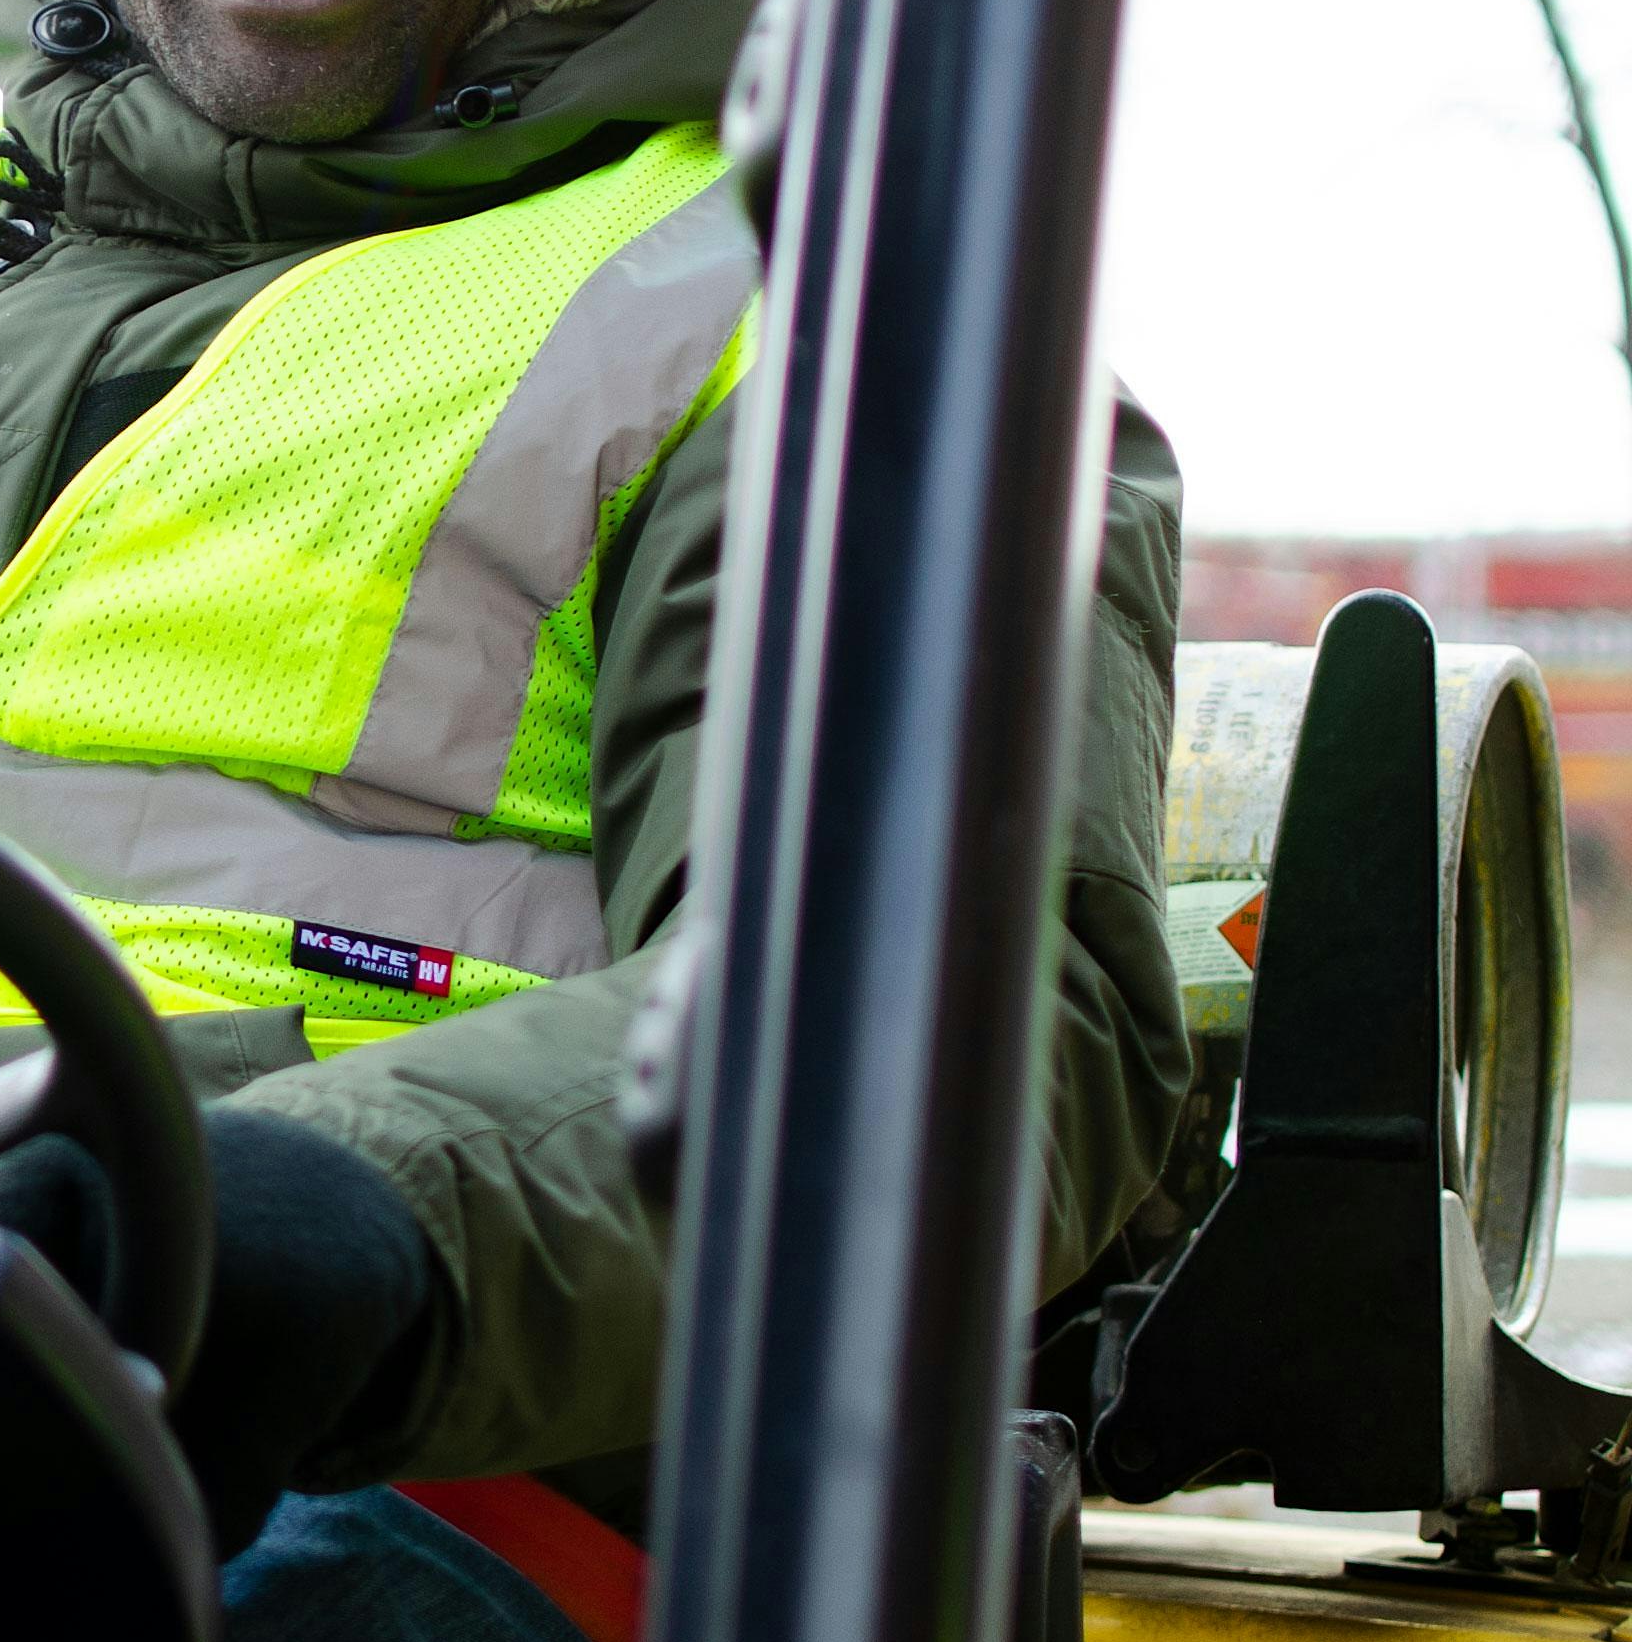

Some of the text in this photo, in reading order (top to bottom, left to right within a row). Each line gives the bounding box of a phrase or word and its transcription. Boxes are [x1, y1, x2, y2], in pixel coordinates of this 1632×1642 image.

[344, 955, 410, 979] BY MAJESTIC
[418, 959, 448, 984] HV
